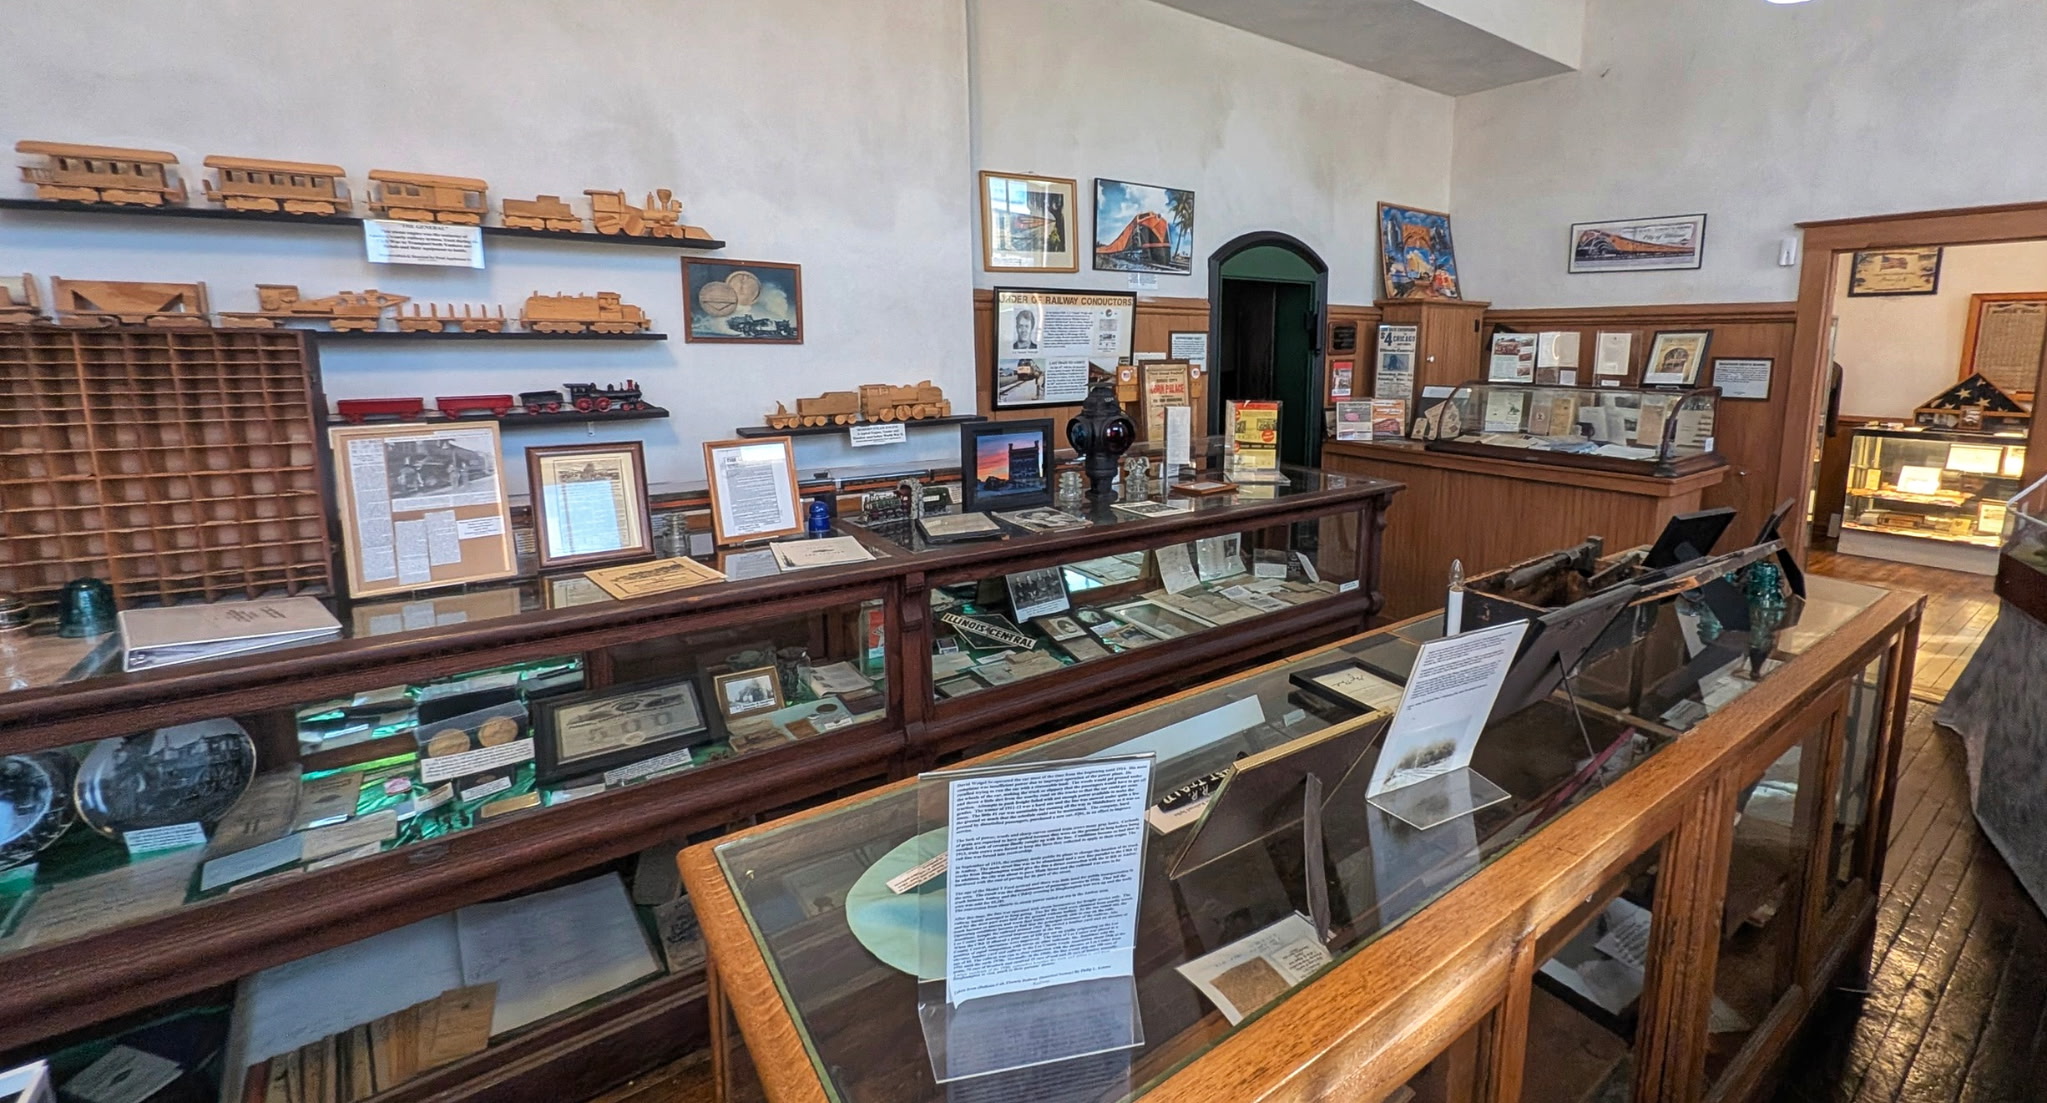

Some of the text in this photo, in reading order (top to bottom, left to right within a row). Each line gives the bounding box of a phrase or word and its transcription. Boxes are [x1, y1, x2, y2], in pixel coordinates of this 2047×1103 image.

[1000, 294, 1028, 304] ORDER
[1045, 296, 1079, 305] RAILWAY
[1081, 297, 1132, 306] CONDUCTORS
[1166, 384, 1184, 393] PALACE
[944, 614, 1034, 648] ILLINOIS CENTRAL
